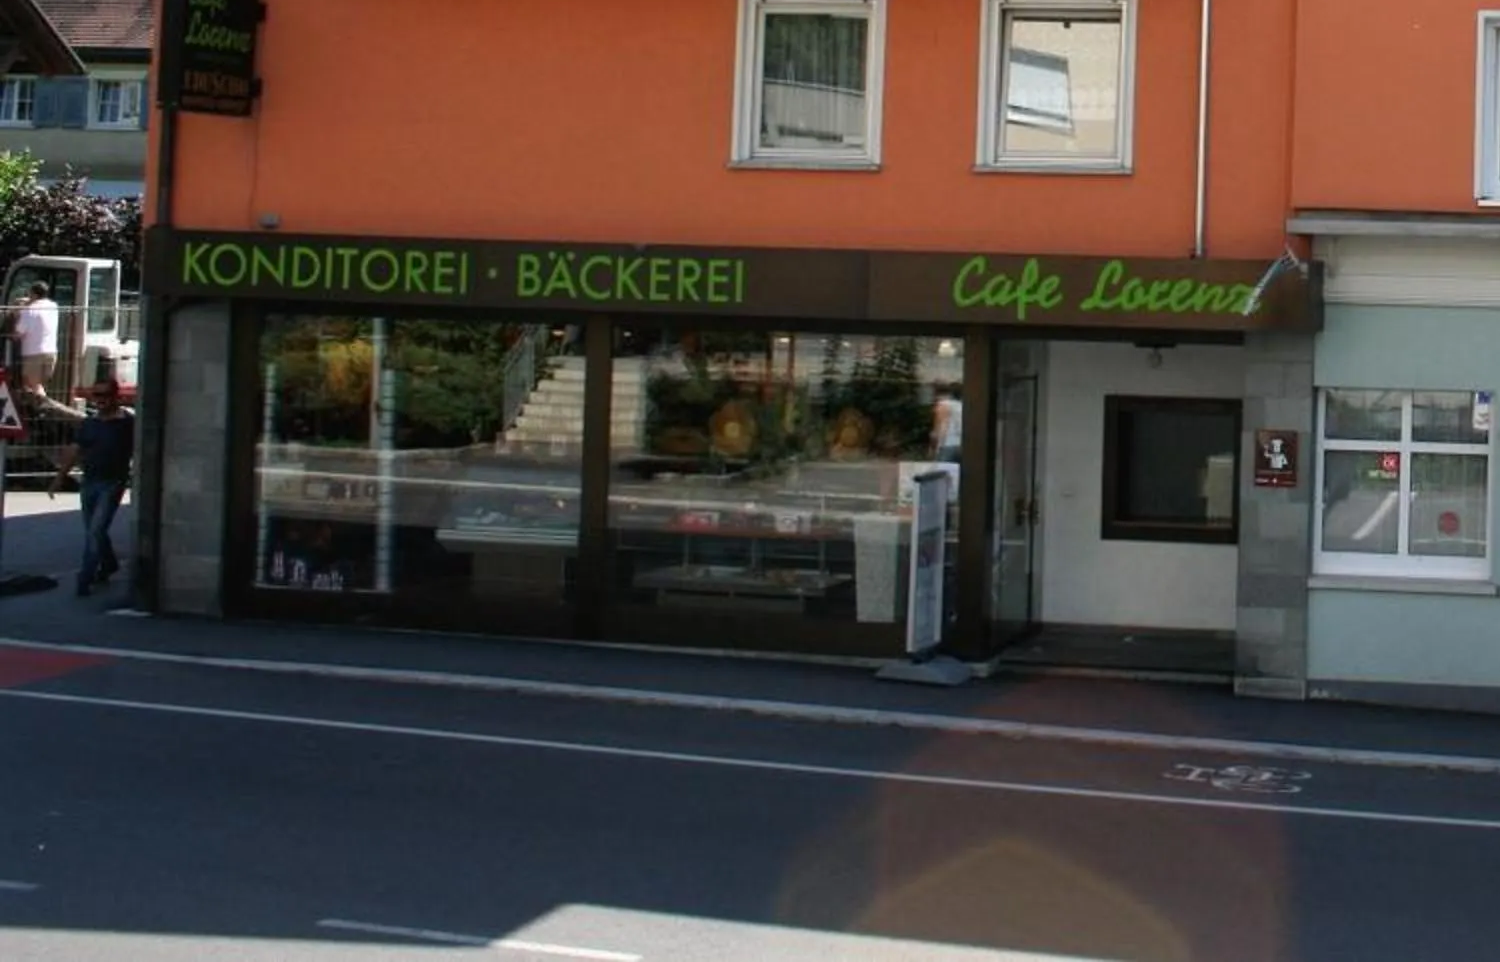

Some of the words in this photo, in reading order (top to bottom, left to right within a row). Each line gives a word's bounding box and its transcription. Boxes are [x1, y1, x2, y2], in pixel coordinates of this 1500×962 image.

[183, 243, 468, 295] KONDITOREI
[517, 251, 745, 303] BÄCKEREI
[953, 256, 1062, 321] Cafe
[1080, 260, 1260, 313] Lorenz
